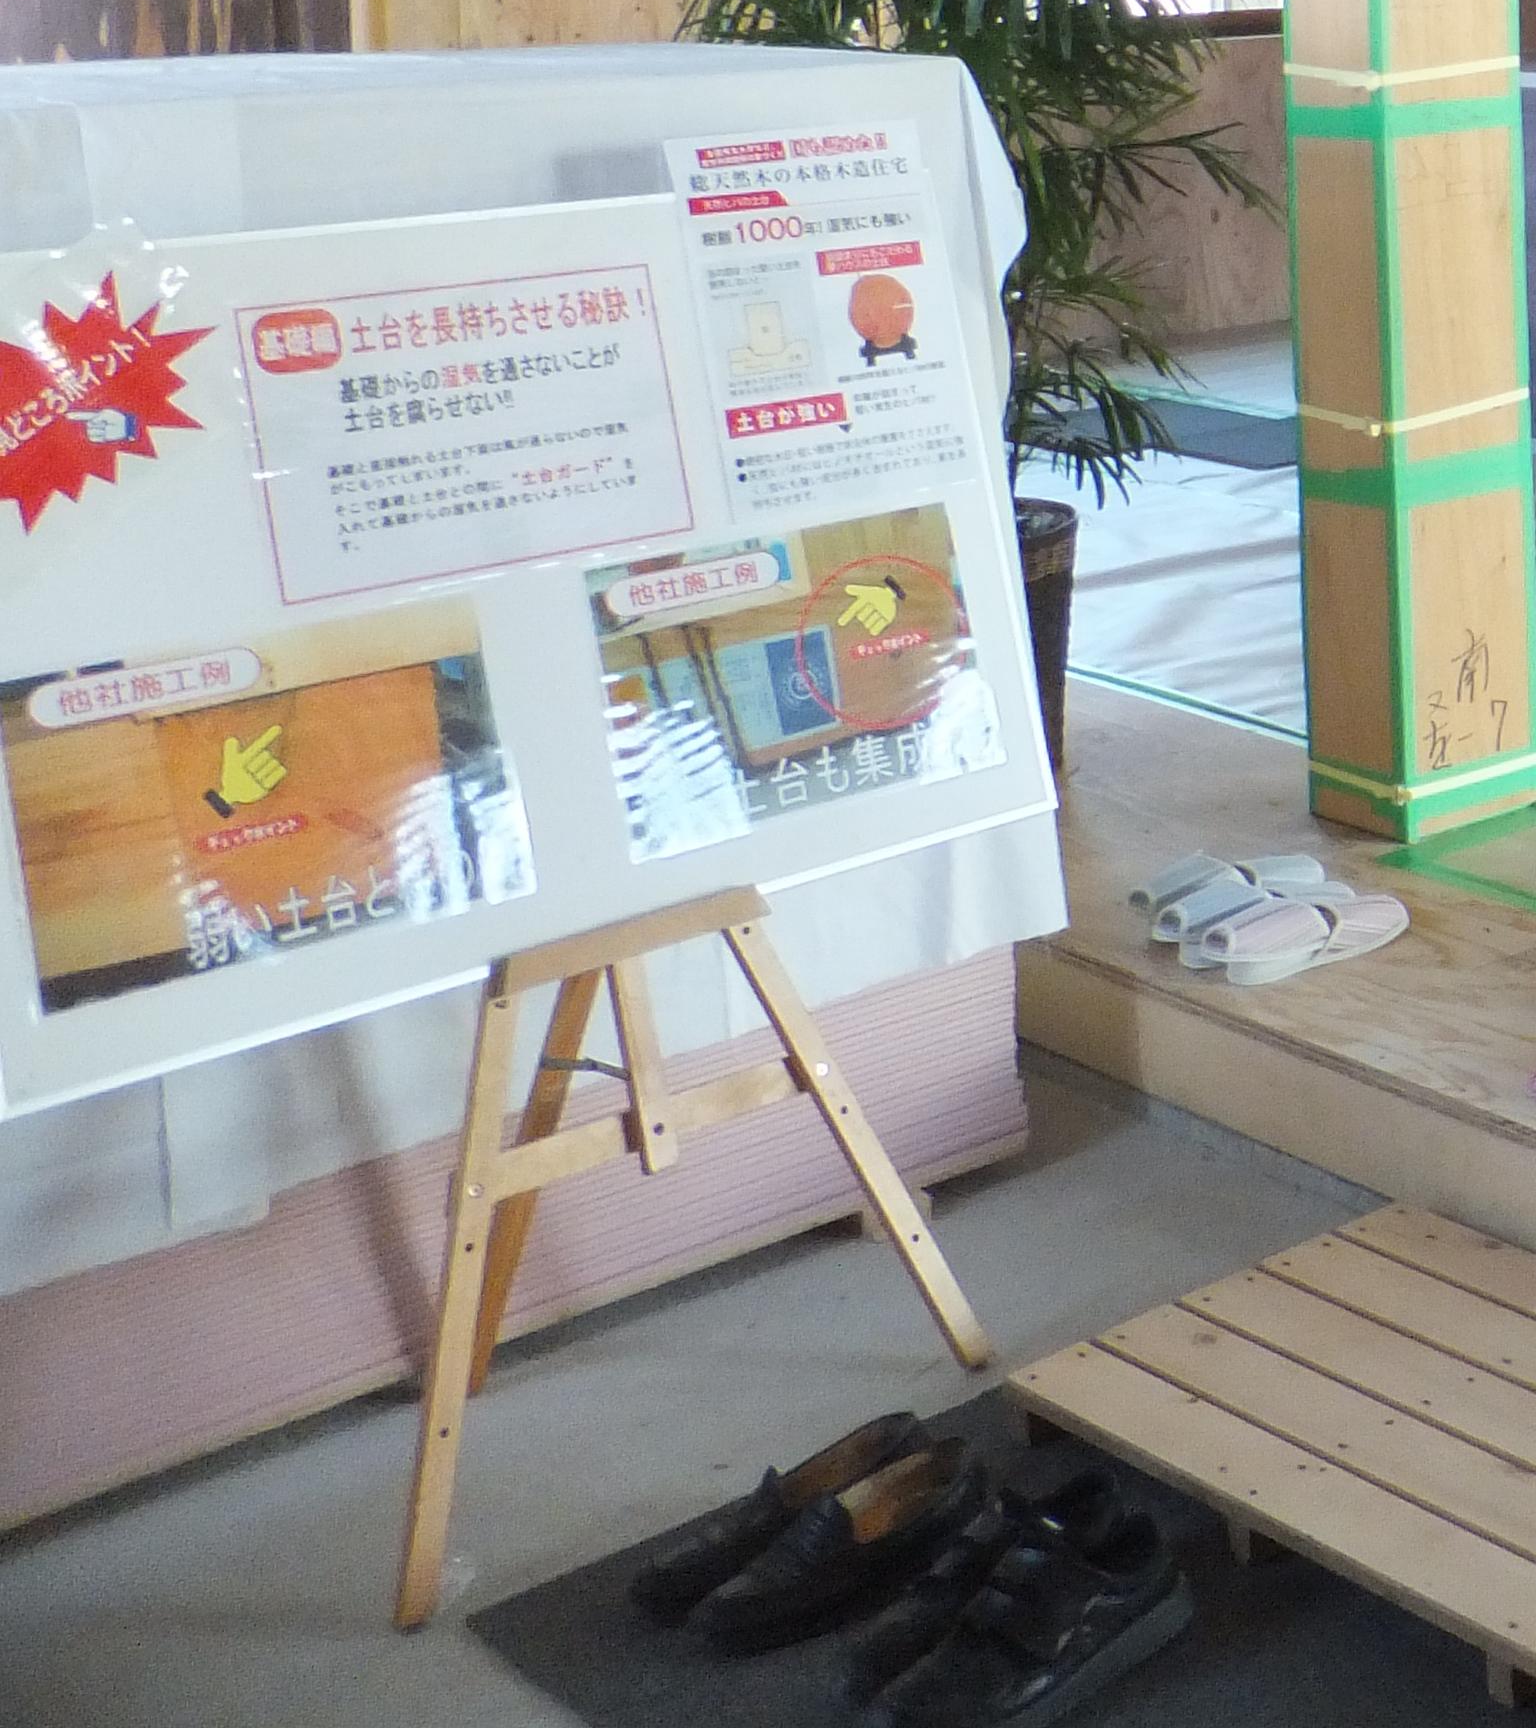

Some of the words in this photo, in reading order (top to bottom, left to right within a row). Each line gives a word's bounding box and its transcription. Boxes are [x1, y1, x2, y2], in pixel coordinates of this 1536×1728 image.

[629, 560, 760, 607] 他社施工例
[58, 658, 232, 718] 他社施工例
